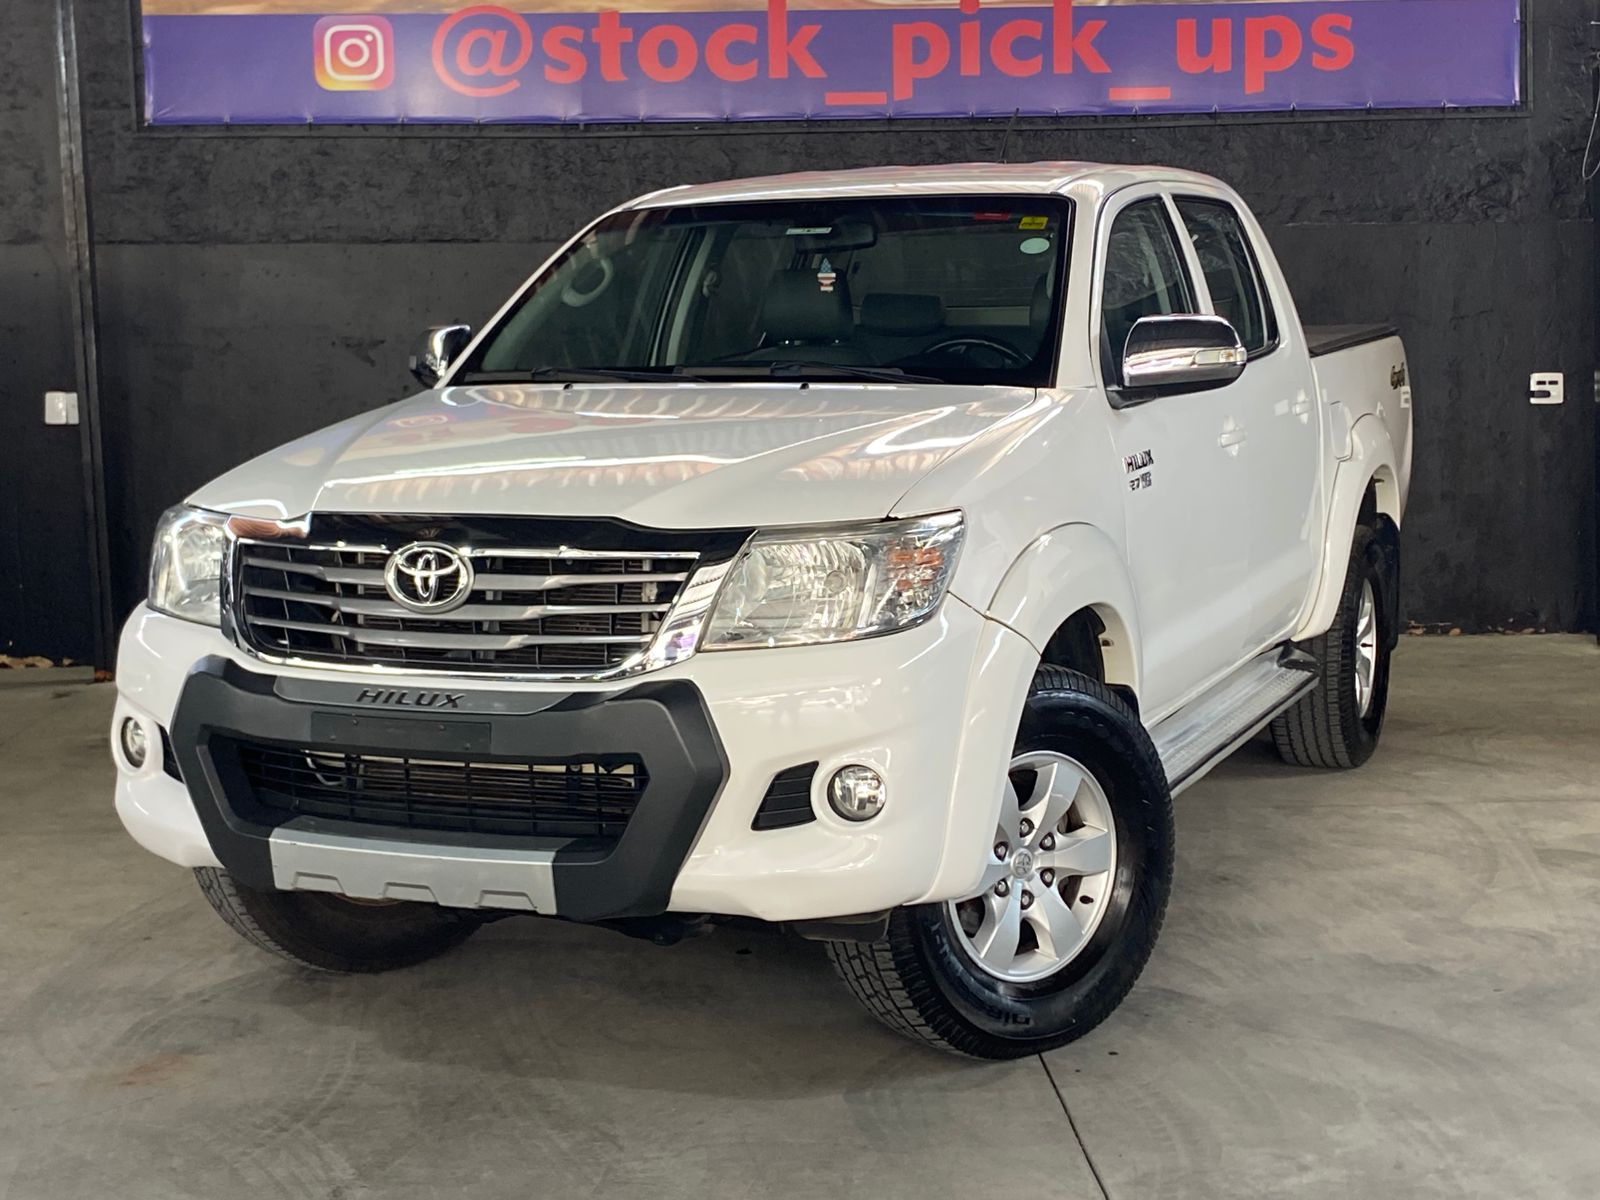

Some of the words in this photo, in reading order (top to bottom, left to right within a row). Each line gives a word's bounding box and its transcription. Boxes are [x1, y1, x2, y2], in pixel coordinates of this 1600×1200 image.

[431, 0, 1356, 106] @stock_pick_ups
[1122, 449, 1154, 473] HILUX
[356, 687, 464, 708] HILUX
